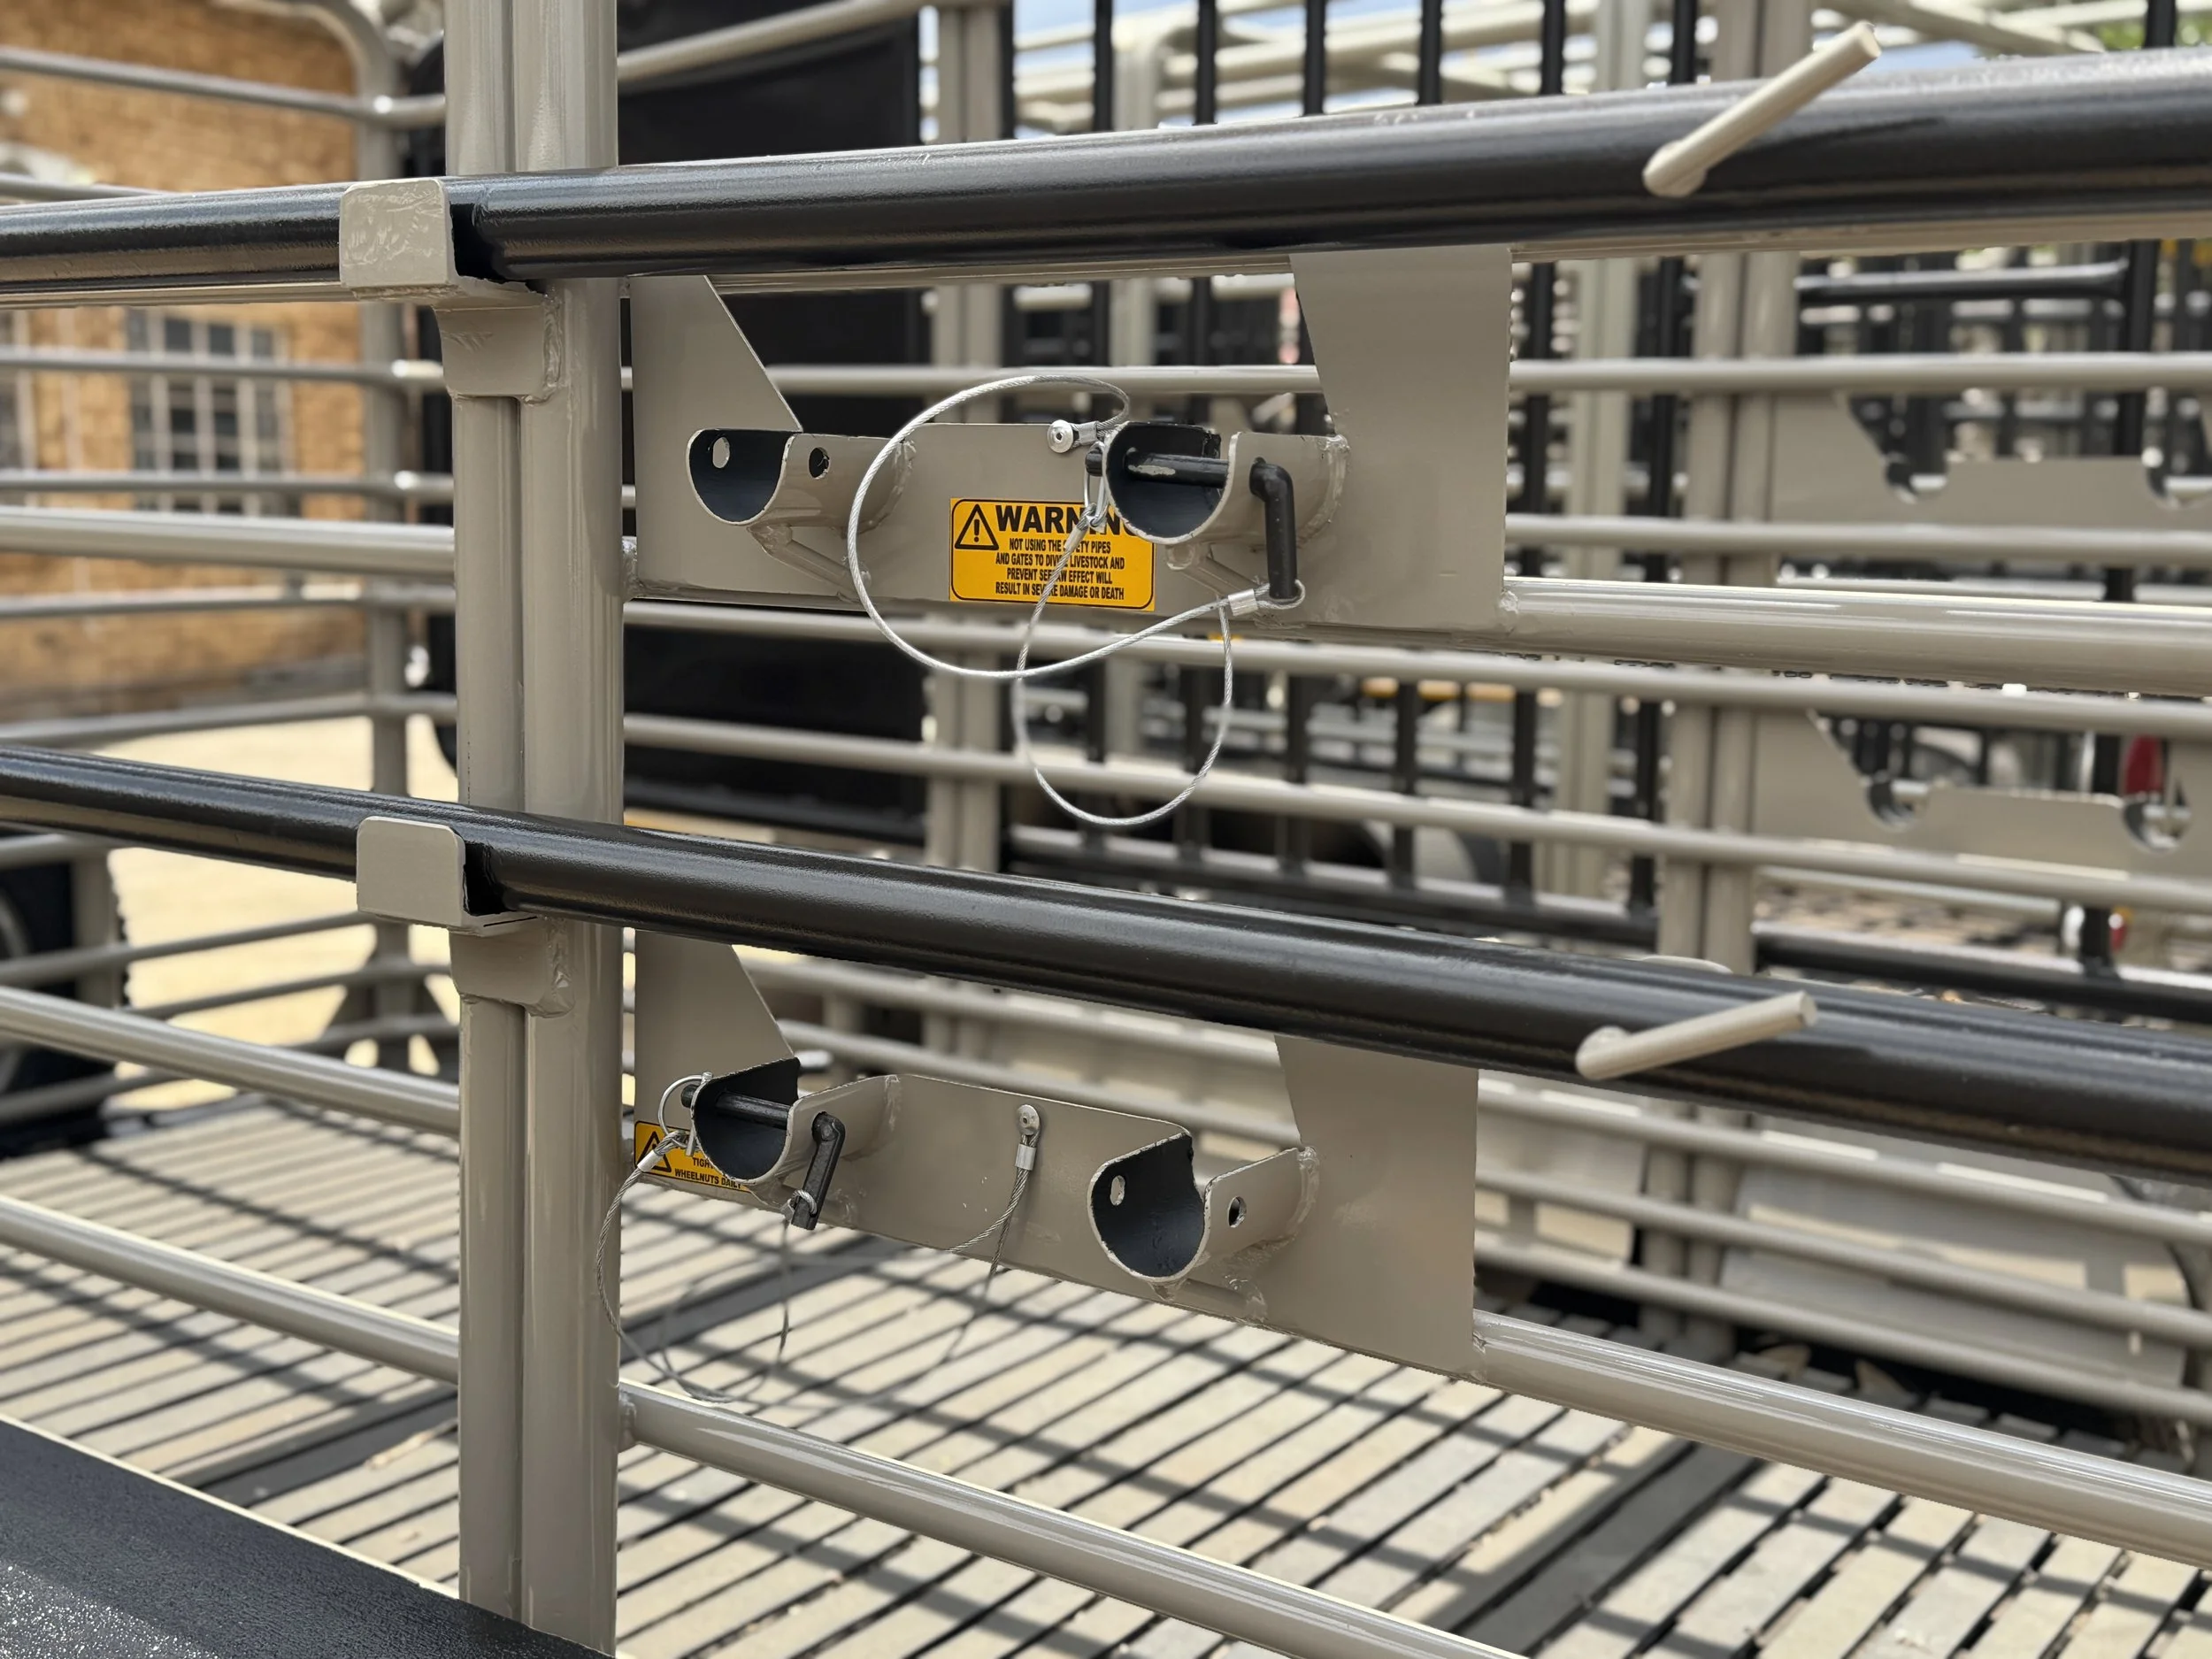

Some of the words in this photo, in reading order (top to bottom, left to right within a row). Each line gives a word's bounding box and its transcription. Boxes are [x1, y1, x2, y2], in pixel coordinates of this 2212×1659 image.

[995, 504, 1138, 536] WARNN
[1009, 538, 1023, 551] NOT
[1025, 538, 1046, 552] USING
[1048, 539, 1062, 552] THE
[1091, 541, 1111, 554] PIPES
[995, 552, 1010, 565] AND
[1011, 553, 1033, 566] GATES
[1035, 554, 1044, 566] TO
[1070, 556, 1109, 569] LIVESTOCK
[1110, 557, 1125, 570] AND
[1007, 567, 1038, 580] PREVENT
[1039, 569, 1067, 582] SEEAW
[1068, 570, 1093, 583] EFFECT
[1094, 572, 1113, 584] WILL
[995, 581, 1021, 595] RESULT
[1023, 583, 1030, 595] IN
[1032, 583, 1057, 597] SEVRE
[1059, 585, 1088, 598] DAMAGE
[1089, 587, 1100, 599] OR
[1101, 587, 1125, 600] DEATH
[693, 1157, 713, 1169] TIGH
[674, 1168, 719, 1185] WHEELNUTS
